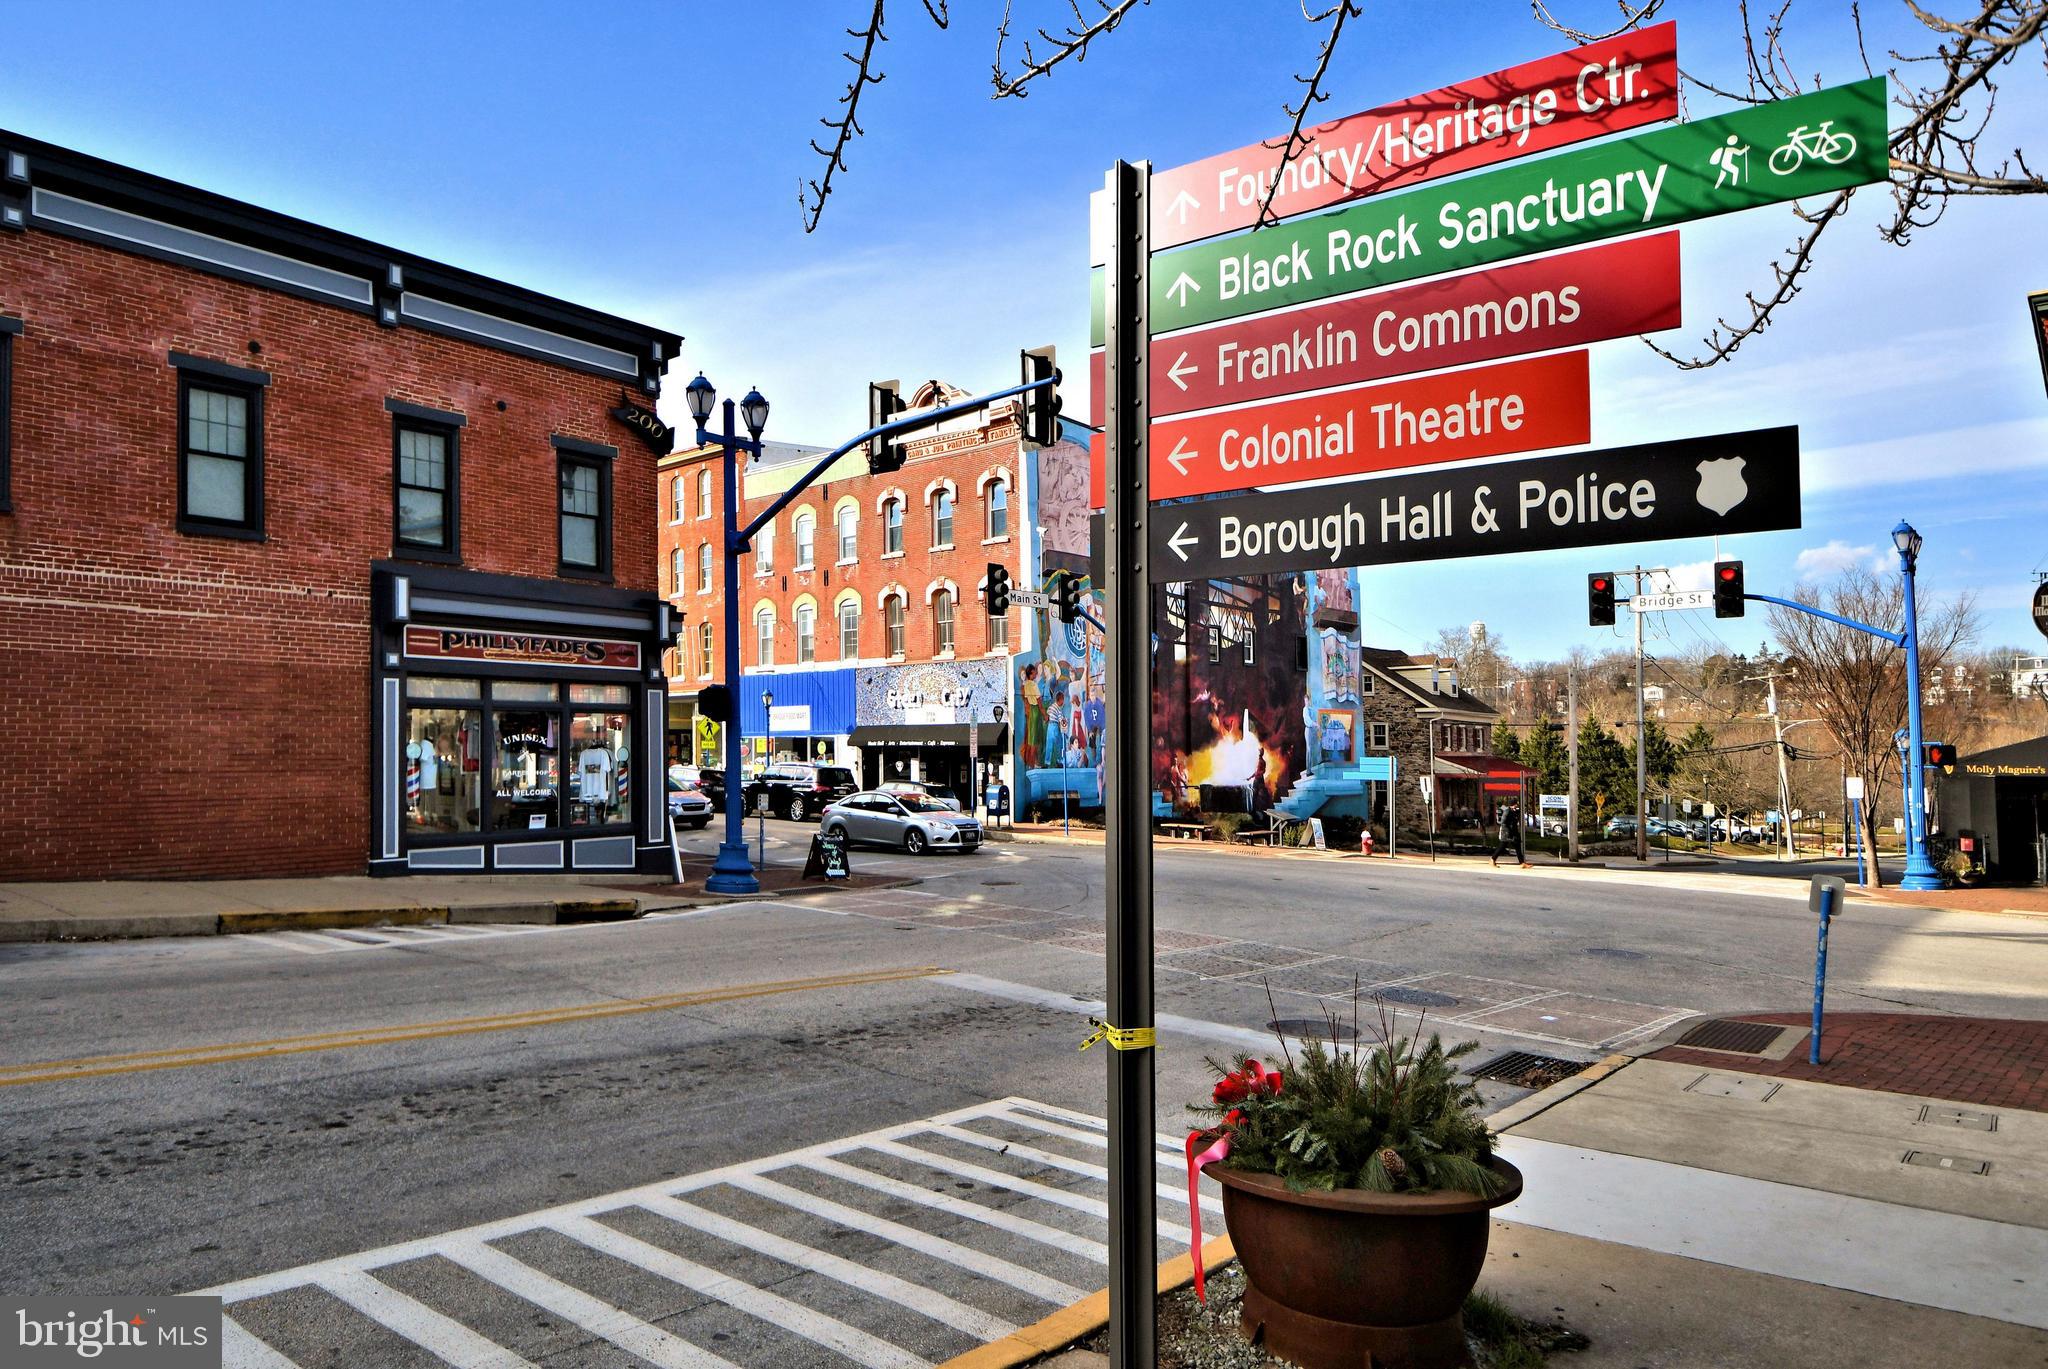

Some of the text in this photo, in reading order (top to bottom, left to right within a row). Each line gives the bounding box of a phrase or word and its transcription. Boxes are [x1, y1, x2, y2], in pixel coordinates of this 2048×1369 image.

[1577, 58, 1649, 113] Ctr.
[1219, 163, 1668, 301] Black Rock Sanctuary
[1218, 286, 1581, 386] Franklin Commons
[627, 408, 664, 438] 200
[1218, 391, 1524, 472] Colonial Theatre
[1219, 473, 1656, 563] Borough Hall & Police
[1010, 593, 1042, 605] Main St
[1640, 594, 1702, 608] Bridge St
[503, 733, 548, 745] UNISEX
[1966, 764, 2046, 776] Molly Maguire's
[496, 788, 552, 797] ALL WELCOME
